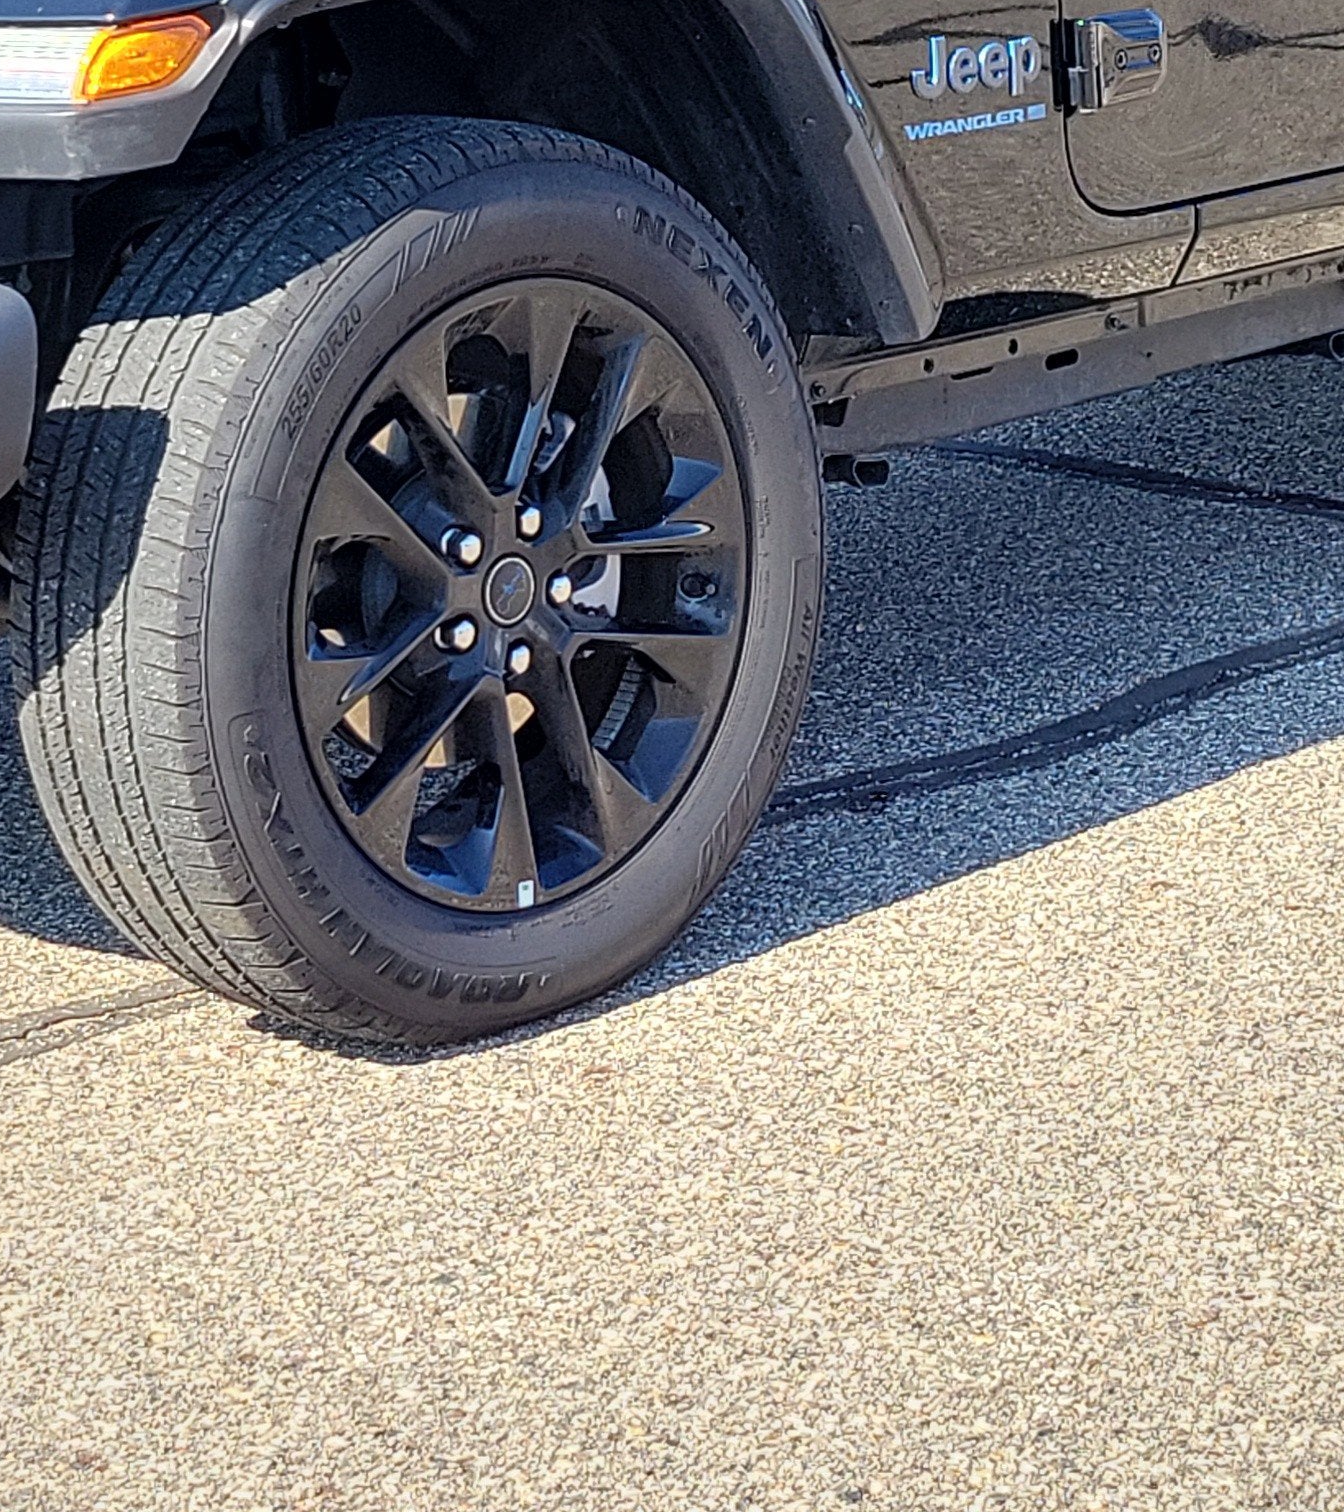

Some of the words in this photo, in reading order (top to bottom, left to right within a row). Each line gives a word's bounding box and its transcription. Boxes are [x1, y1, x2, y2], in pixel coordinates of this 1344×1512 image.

[910, 34, 1042, 100] Jeep
[904, 108, 1025, 141] WRANGLER
[632, 204, 774, 362] NEXEN
[280, 302, 362, 439] 255/60R20
